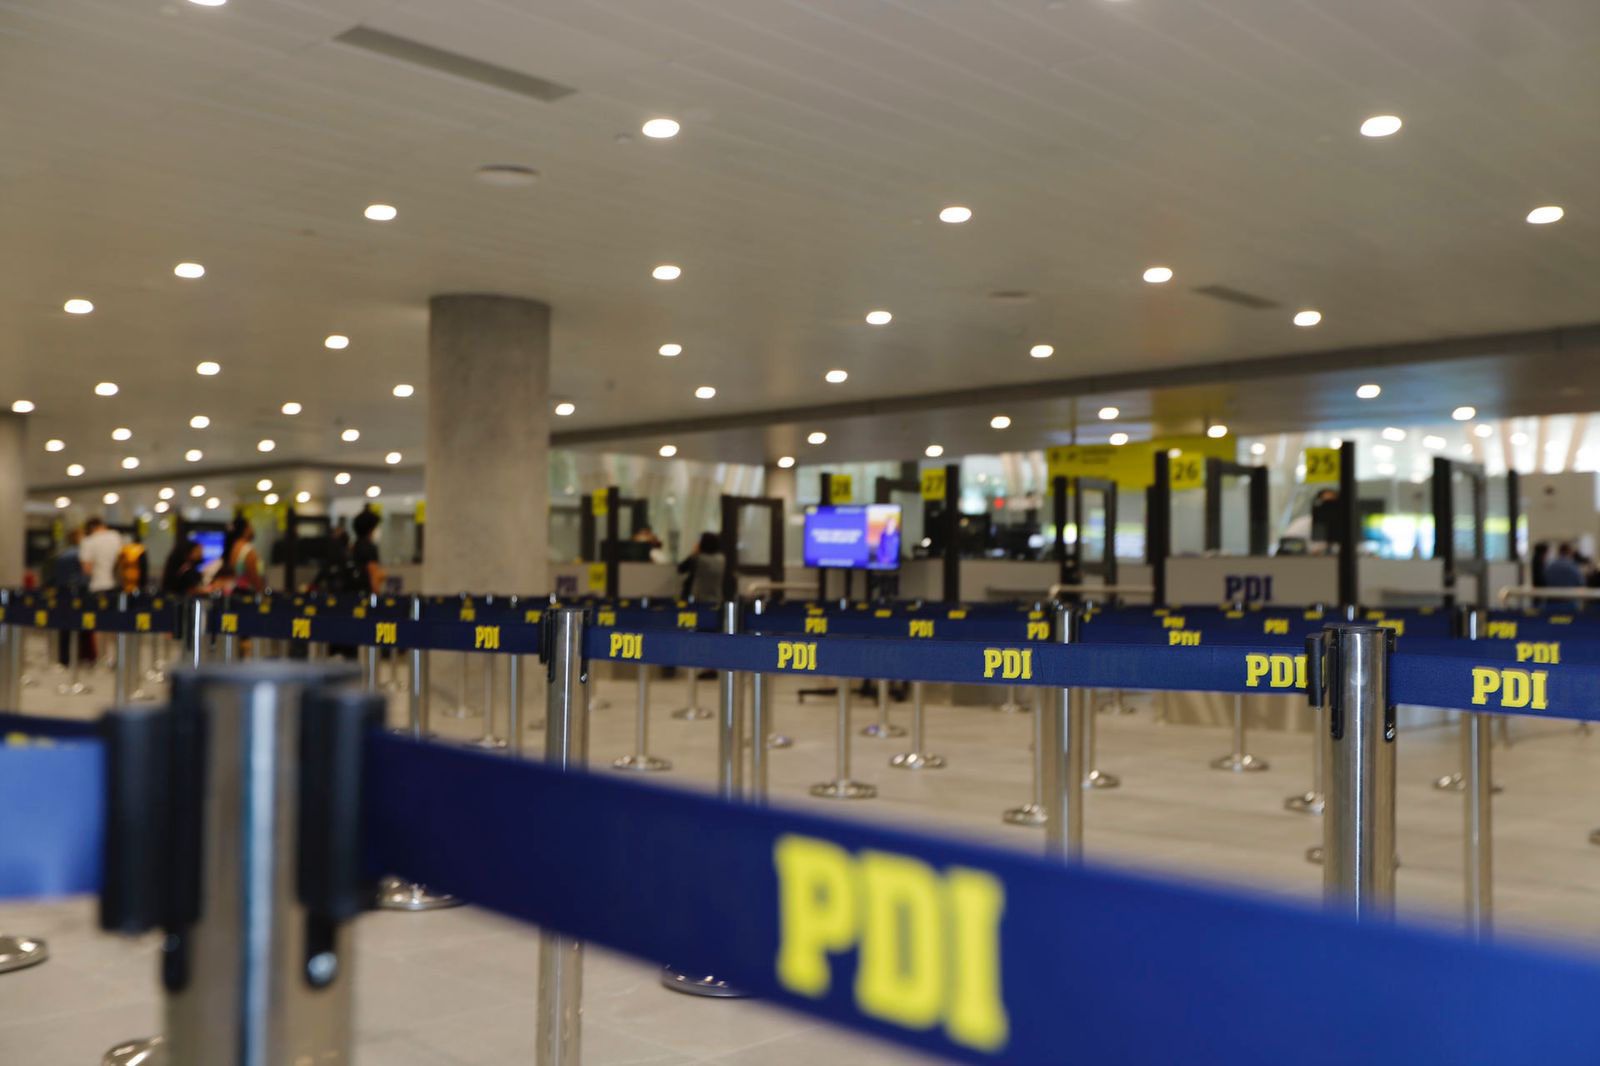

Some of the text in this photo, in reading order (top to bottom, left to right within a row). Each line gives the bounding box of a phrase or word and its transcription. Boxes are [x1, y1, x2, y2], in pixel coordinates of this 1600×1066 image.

[1173, 461, 1199, 481] 26
[1308, 455, 1335, 475] 25
[1225, 575, 1274, 602] PDI
[376, 622, 397, 644] PDI
[475, 625, 500, 649] PDI
[805, 617, 828, 633] PDI
[909, 620, 934, 638] PDI
[1027, 621, 1050, 639] PD
[609, 632, 643, 659] PDI
[777, 642, 817, 670] PDI
[1516, 642, 1560, 664] PDI
[984, 649, 1033, 679] PDI
[1246, 653, 1308, 689] PDI
[1471, 667, 1548, 710] PDI
[775, 835, 1008, 1050] PDI
